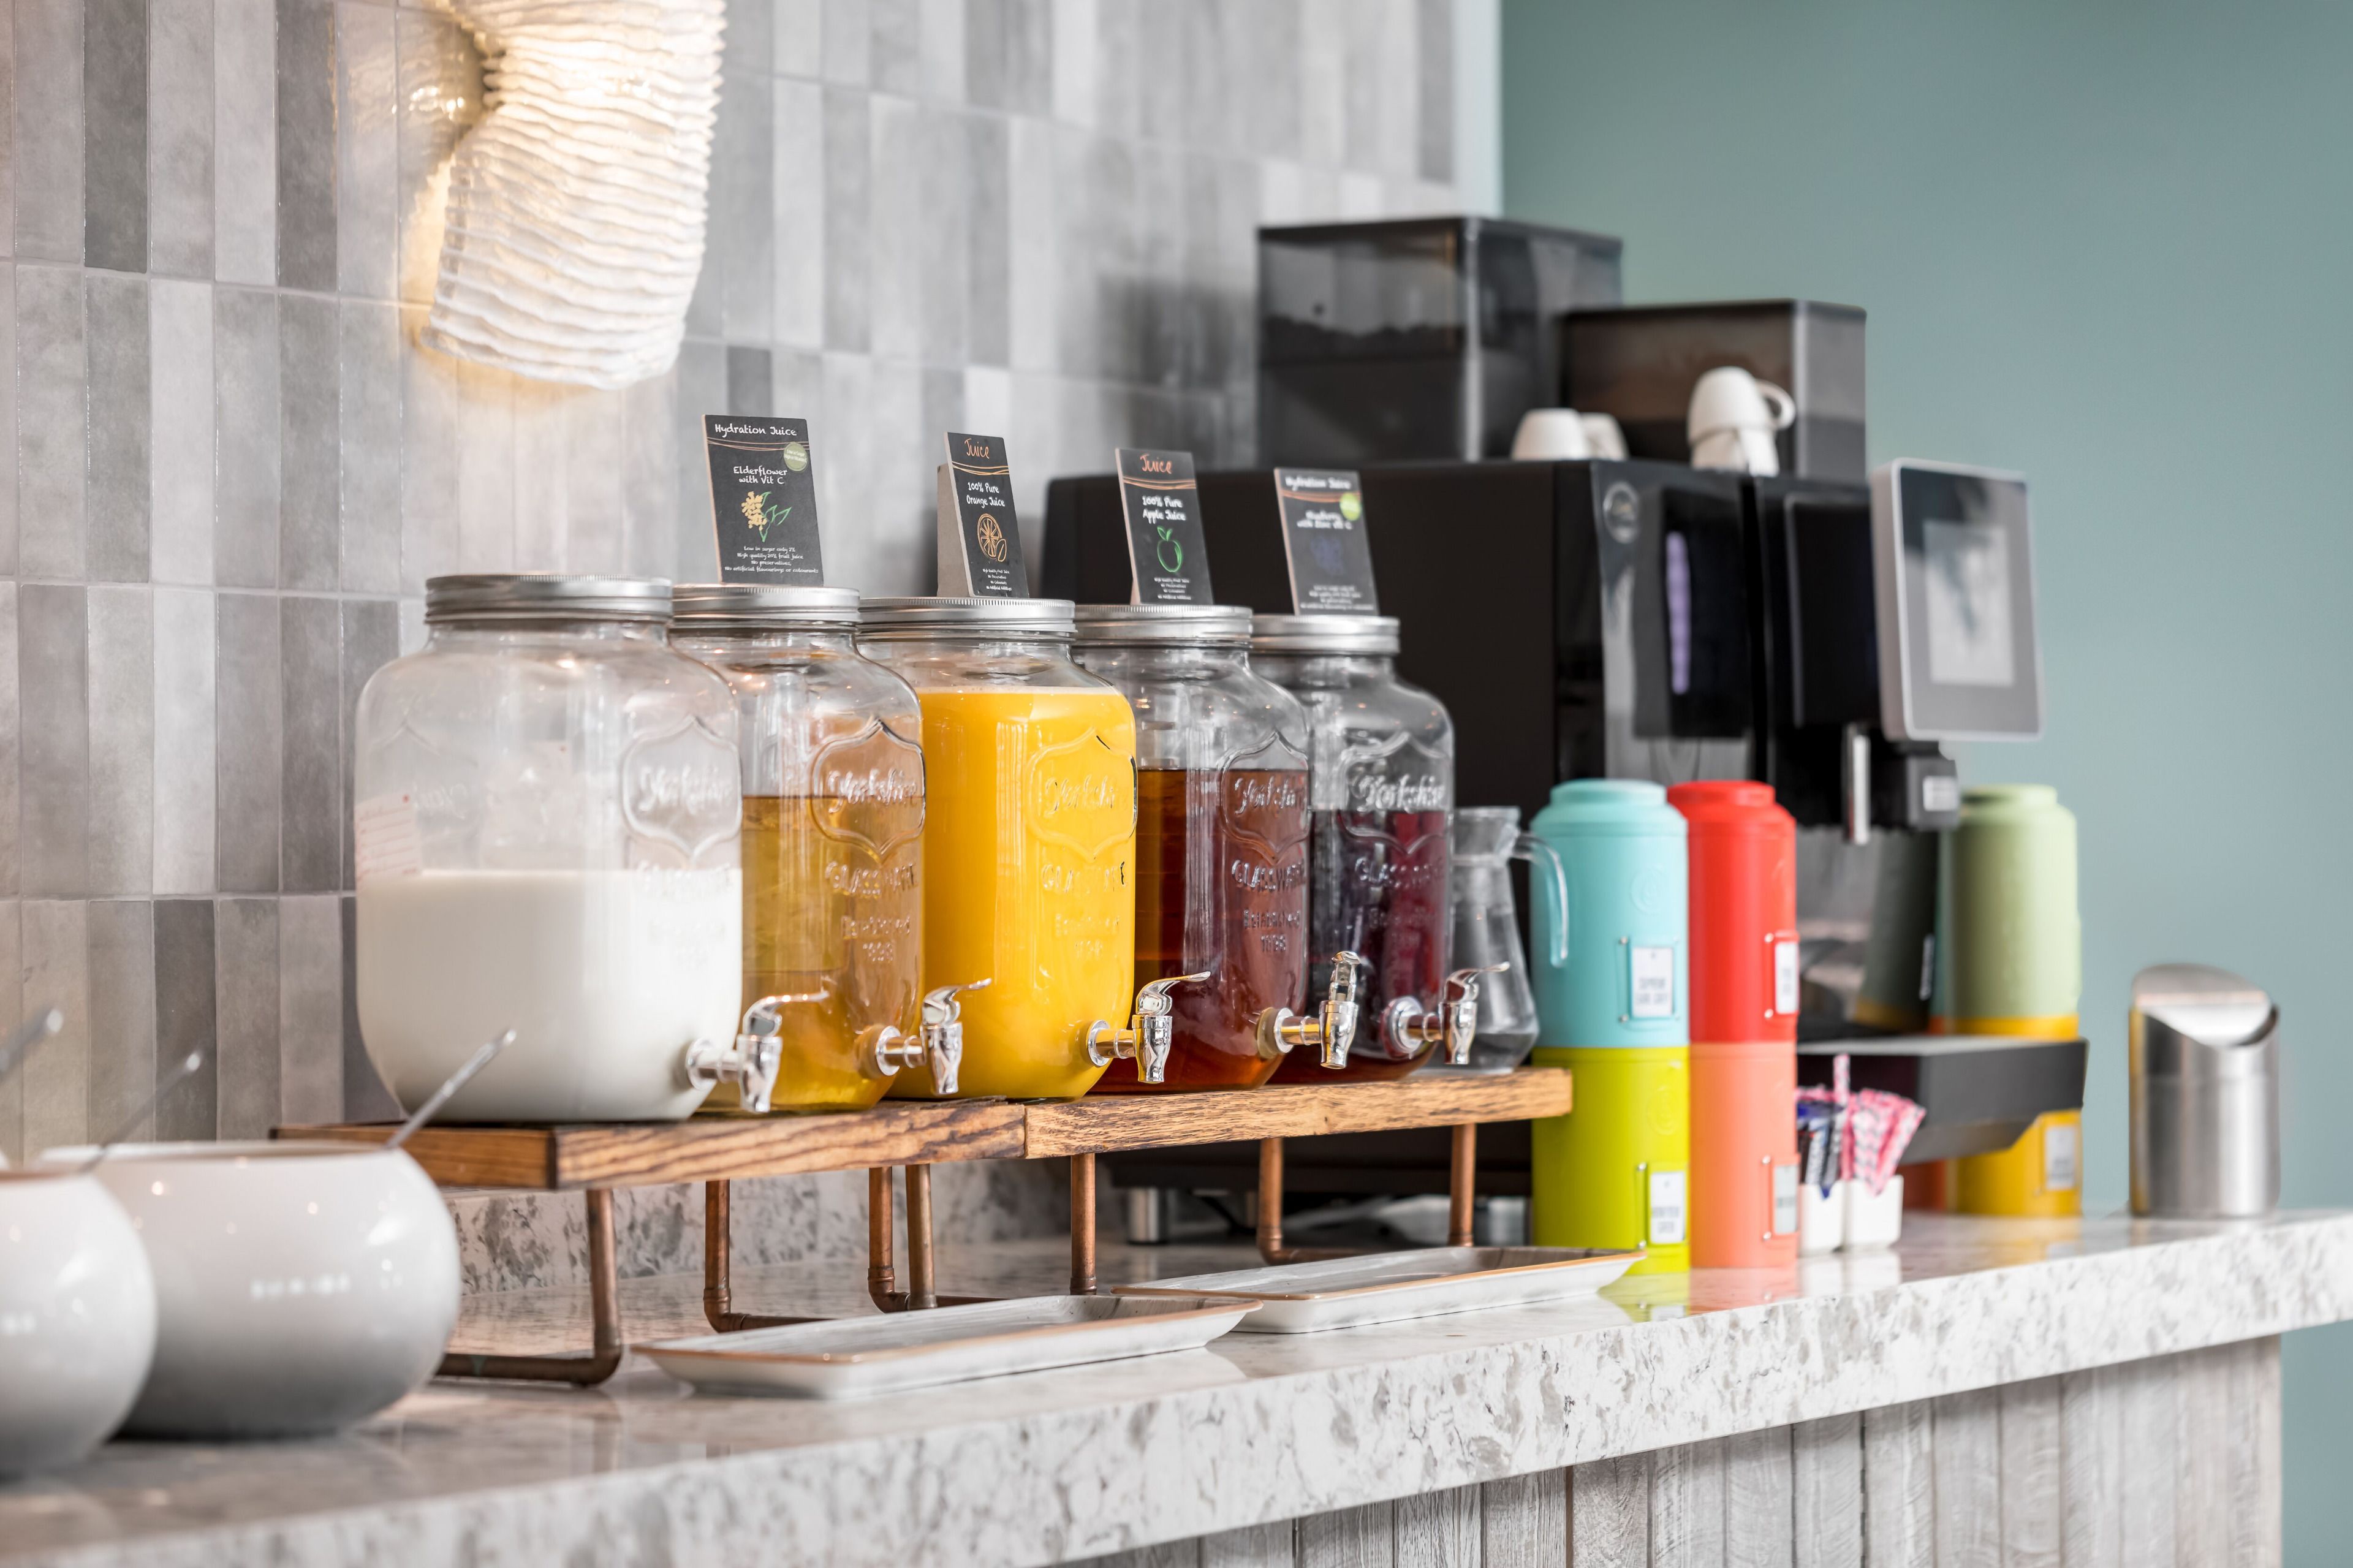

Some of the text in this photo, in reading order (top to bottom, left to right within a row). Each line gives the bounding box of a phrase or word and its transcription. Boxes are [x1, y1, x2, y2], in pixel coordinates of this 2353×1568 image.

[714, 423, 797, 437] Hydration Juice
[964, 437, 990, 459] Juice
[733, 465, 787, 477] Elderflower
[1140, 454, 1172, 474] Juice
[968, 482, 999, 493] 100% Pure
[966, 495, 1006, 509] Orange Juice
[1142, 495, 1183, 508] 100% Pure
[1143, 509, 1186, 524] Apple Juice
